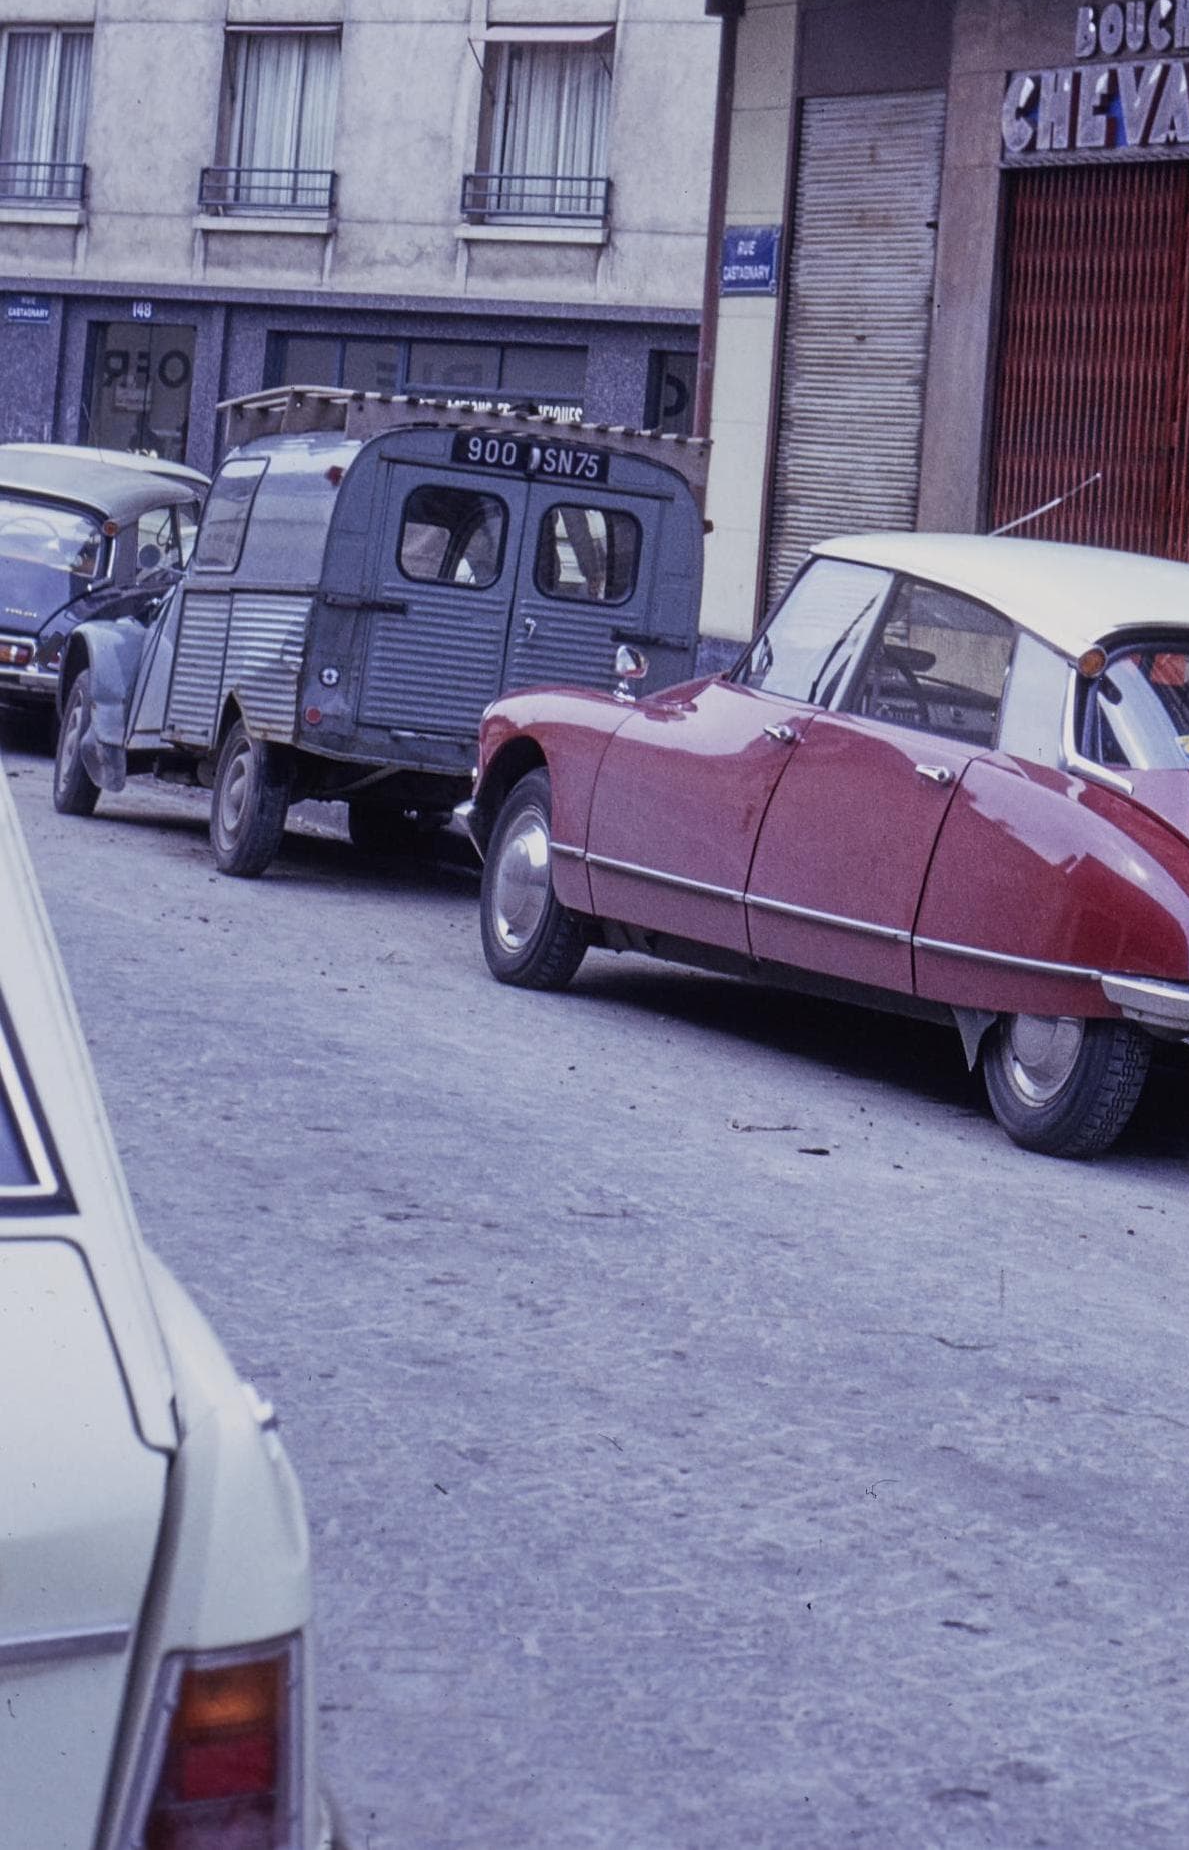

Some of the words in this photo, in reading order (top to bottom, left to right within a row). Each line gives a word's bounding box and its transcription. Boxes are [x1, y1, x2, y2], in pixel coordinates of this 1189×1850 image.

[737, 240, 757, 256] RUE
[132, 301, 152, 318] 148
[468, 437, 517, 466] 900
